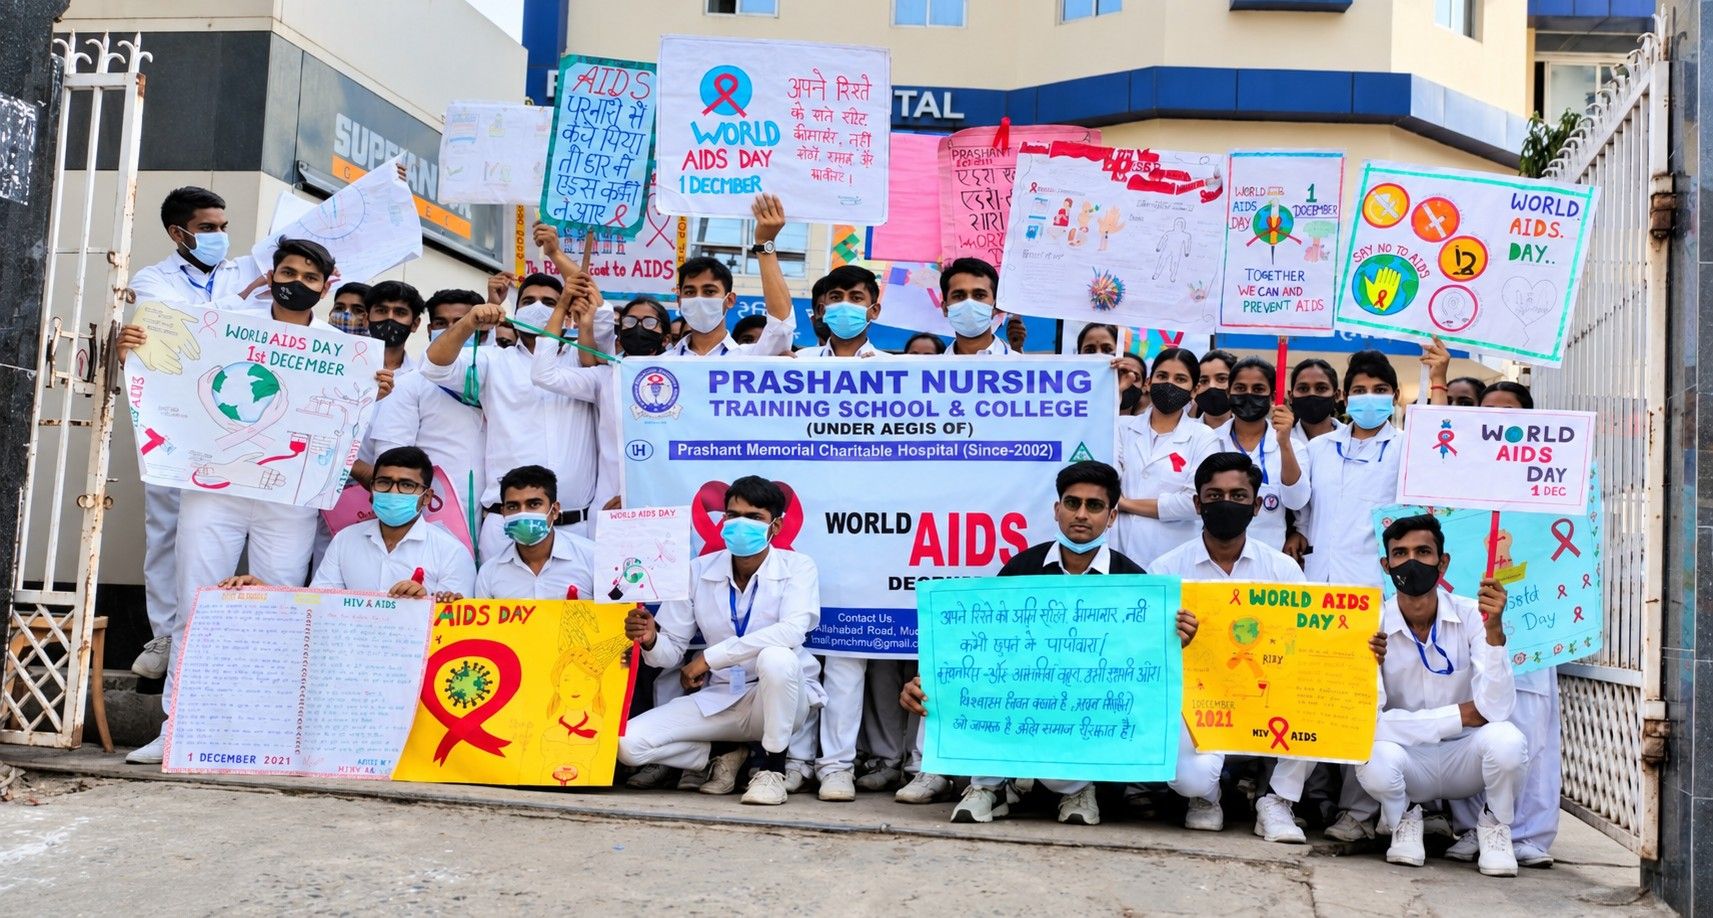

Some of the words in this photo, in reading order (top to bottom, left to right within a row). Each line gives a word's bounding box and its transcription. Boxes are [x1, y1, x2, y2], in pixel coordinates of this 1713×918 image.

[572, 66, 651, 99] AIDS
[787, 68, 827, 101] अपने
[690, 120, 781, 146] WORLD
[682, 149, 728, 170] AIDS
[740, 149, 773, 169] DAY
[679, 175, 685, 193] 1
[690, 175, 763, 194] DECMBER
[1235, 187, 1266, 197] WORLD
[1306, 183, 1317, 203] 1
[1232, 201, 1257, 212] AIDS
[1229, 217, 1251, 231] DAY
[631, 260, 674, 279] AIDS
[1353, 245, 1373, 263] SAY
[1377, 243, 1392, 253] NO
[1396, 245, 1409, 257] TO
[1408, 253, 1431, 279] AIDS
[1245, 268, 1306, 282] TOGETHER
[1238, 285, 1256, 296] WE
[1257, 286, 1279, 297] CAN
[1282, 287, 1303, 297] AND
[1243, 300, 1292, 314] PREVENT
[1295, 299, 1324, 313] AIDS
[268, 333, 307, 351] AIDS
[312, 338, 343, 357] DAY
[246, 345, 266, 364] 1st
[269, 351, 345, 376] DECEMBER
[708, 370, 909, 394] PRASHANT
[921, 370, 1092, 394] NURSING
[709, 400, 830, 417] TRAINING
[838, 400, 940, 418] SCHOOL
[948, 400, 966, 418] &
[975, 400, 1089, 418] COLLEGE
[807, 422, 875, 438] (UNDER
[880, 422, 937, 436] AEGIS
[942, 422, 974, 438] OF)
[677, 444, 742, 456] Prashant
[746, 444, 814, 457] Memorial
[818, 444, 893, 457] Charitable
[898, 443, 958, 459] Hospital
[963, 443, 1054, 460] (Since-2002)
[1496, 445, 1553, 463] AIDS
[1527, 466, 1568, 483] DAY
[1531, 484, 1540, 496] 1
[1544, 486, 1567, 497] DEC
[659, 509, 676, 517] DAY
[825, 512, 912, 535] WORLD
[908, 512, 1030, 568] AIDS
[344, 598, 364, 608] HIV
[375, 599, 396, 609] AIDS
[1249, 589, 1312, 608] WORLD
[1322, 592, 1370, 611] AIDS
[434, 605, 490, 627] AIDS
[498, 606, 536, 625] DAY
[838, 612, 876, 623] Contact
[1296, 613, 1335, 630] DAY
[1522, 612, 1556, 631] Day
[867, 625, 897, 637] Road,
[1195, 709, 1234, 728] 2021
[1290, 731, 1317, 742] AIDS
[188, 752, 193, 762] 1
[200, 752, 256, 764] DECEMBER
[264, 756, 291, 765] 2021
